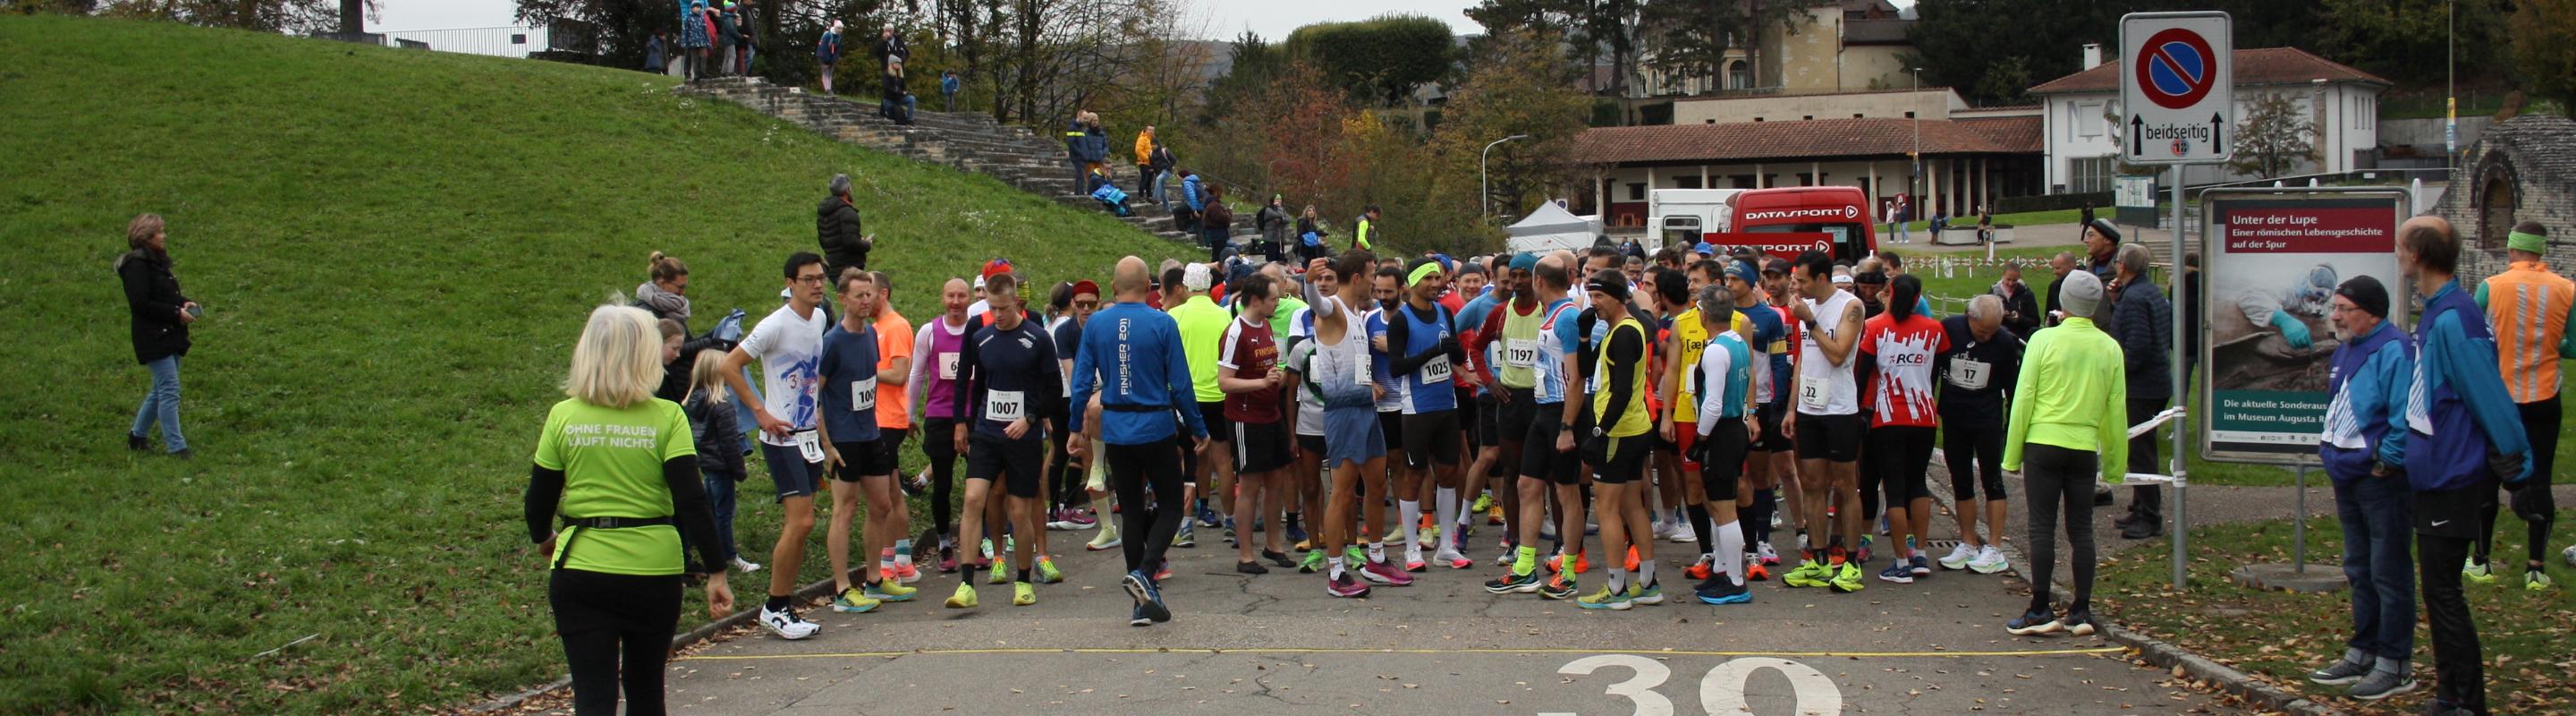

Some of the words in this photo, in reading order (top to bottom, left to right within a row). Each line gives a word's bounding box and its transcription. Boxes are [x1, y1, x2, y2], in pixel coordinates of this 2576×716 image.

[2146, 123, 2208, 143] beidseitig
[1746, 209, 1843, 220] DATASPORT
[2232, 215, 2265, 225] Unter
[2267, 215, 2286, 225] der
[2289, 215, 2318, 227] Lupe
[2232, 228, 2255, 236] Einer
[2256, 228, 2302, 237] römischen
[2304, 227, 2383, 238] Lebensgeschichte
[2232, 240, 2246, 249] auf
[2248, 240, 2263, 249] der
[2265, 240, 2287, 251] Spur
[1118, 318, 1127, 341] 2011
[1509, 348, 1534, 362] 1197
[1896, 354, 1923, 364] RCB
[1118, 343, 1129, 396] FINISHER
[1425, 362, 1449, 377] 1025
[1963, 369, 1977, 380] 17
[859, 387, 876, 404] 100
[1806, 386, 1817, 398] 22
[991, 400, 1019, 414] 1007
[2224, 399, 2239, 407] Die
[2241, 399, 2277, 409] aktuelle
[2279, 400, 2328, 410] Sonderaus
[2224, 413, 2236, 421] im
[2238, 413, 2276, 422] Museum
[2278, 413, 2316, 424] Augusta
[564, 423, 602, 435] OHNE
[606, 424, 657, 437] FRAUEN
[569, 434, 606, 448] LÄUFT
[610, 436, 657, 449] NICHTS
[804, 440, 815, 454] 11
